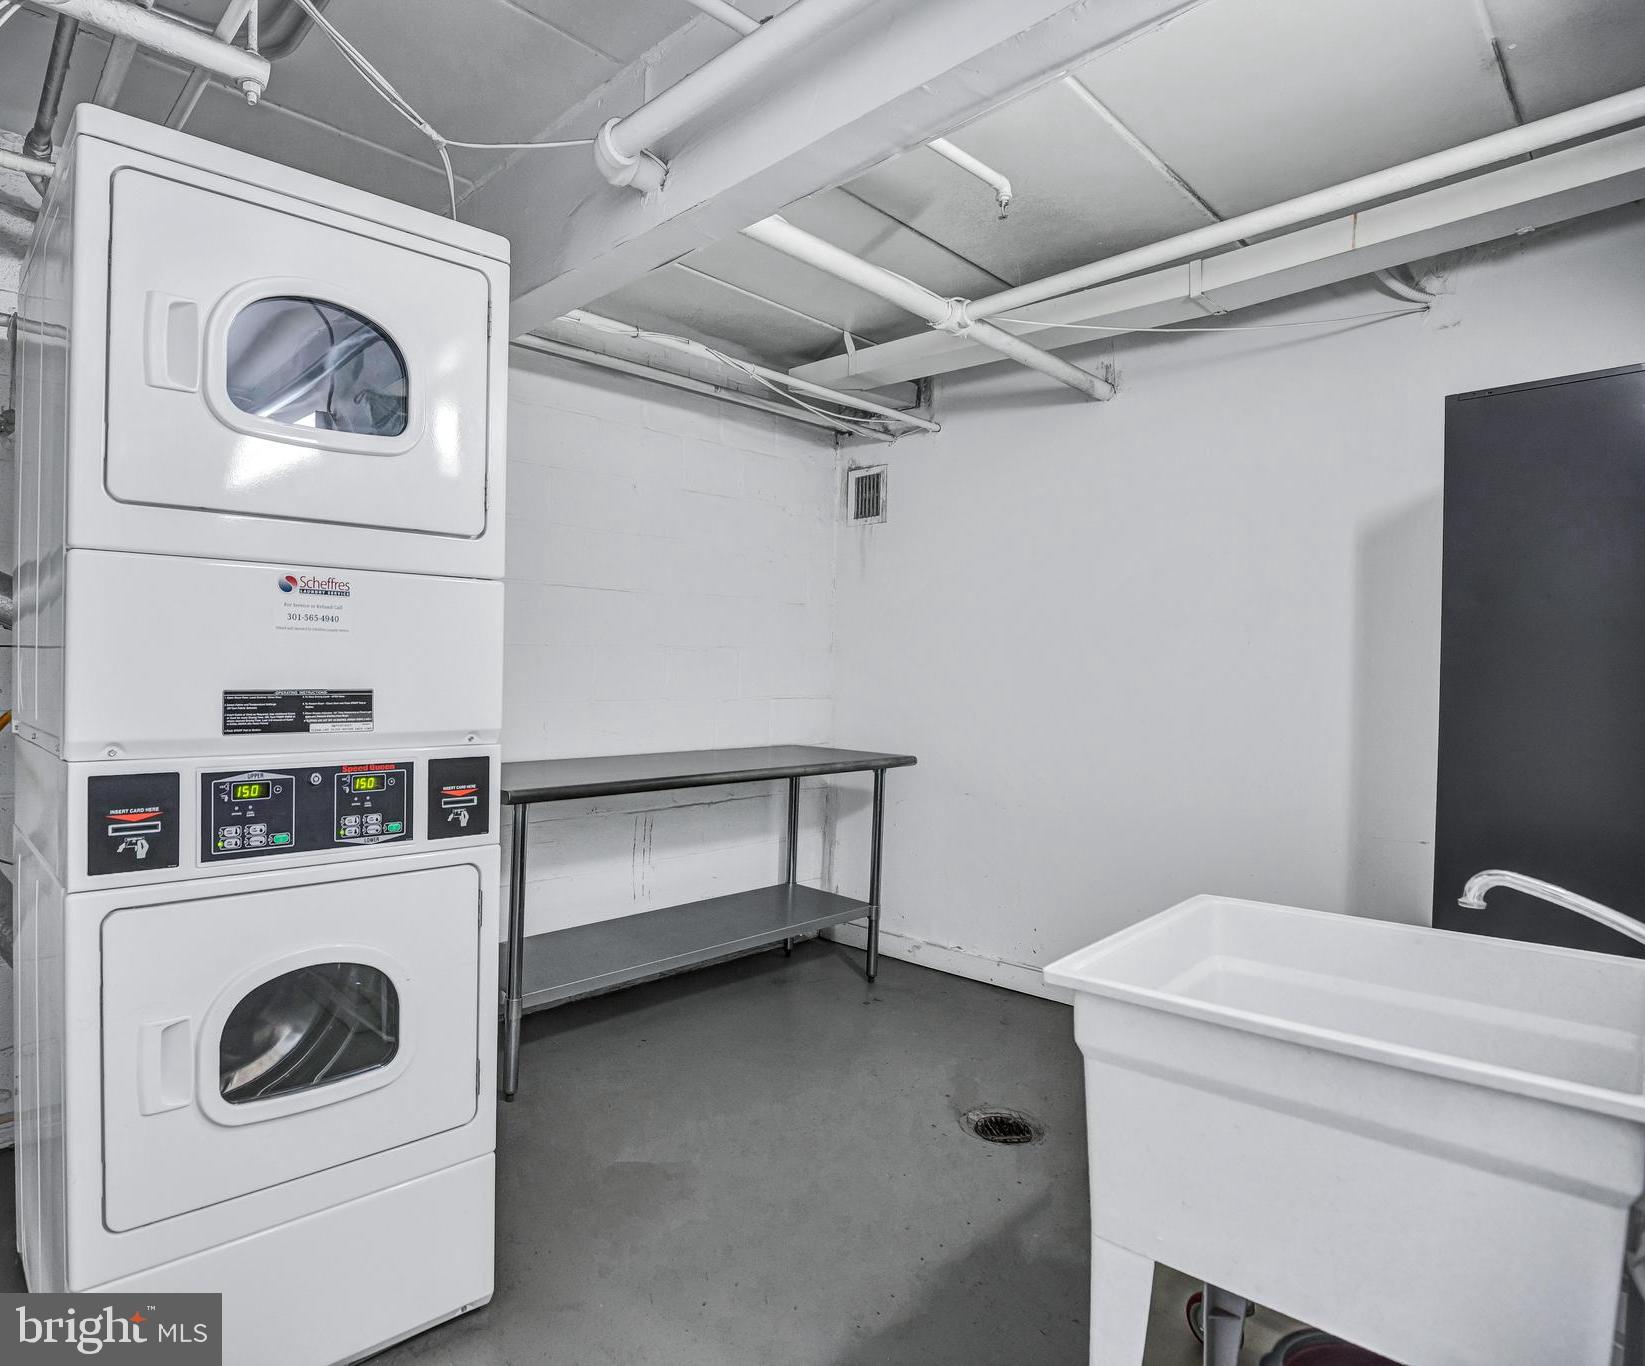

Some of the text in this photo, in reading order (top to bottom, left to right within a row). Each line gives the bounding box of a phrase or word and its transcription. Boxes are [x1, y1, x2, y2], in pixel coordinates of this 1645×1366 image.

[299, 575, 350, 591] Scheffres
[287, 613, 340, 622] 301-565-4940
[356, 777, 375, 789] 150
[237, 785, 259, 797] 150
